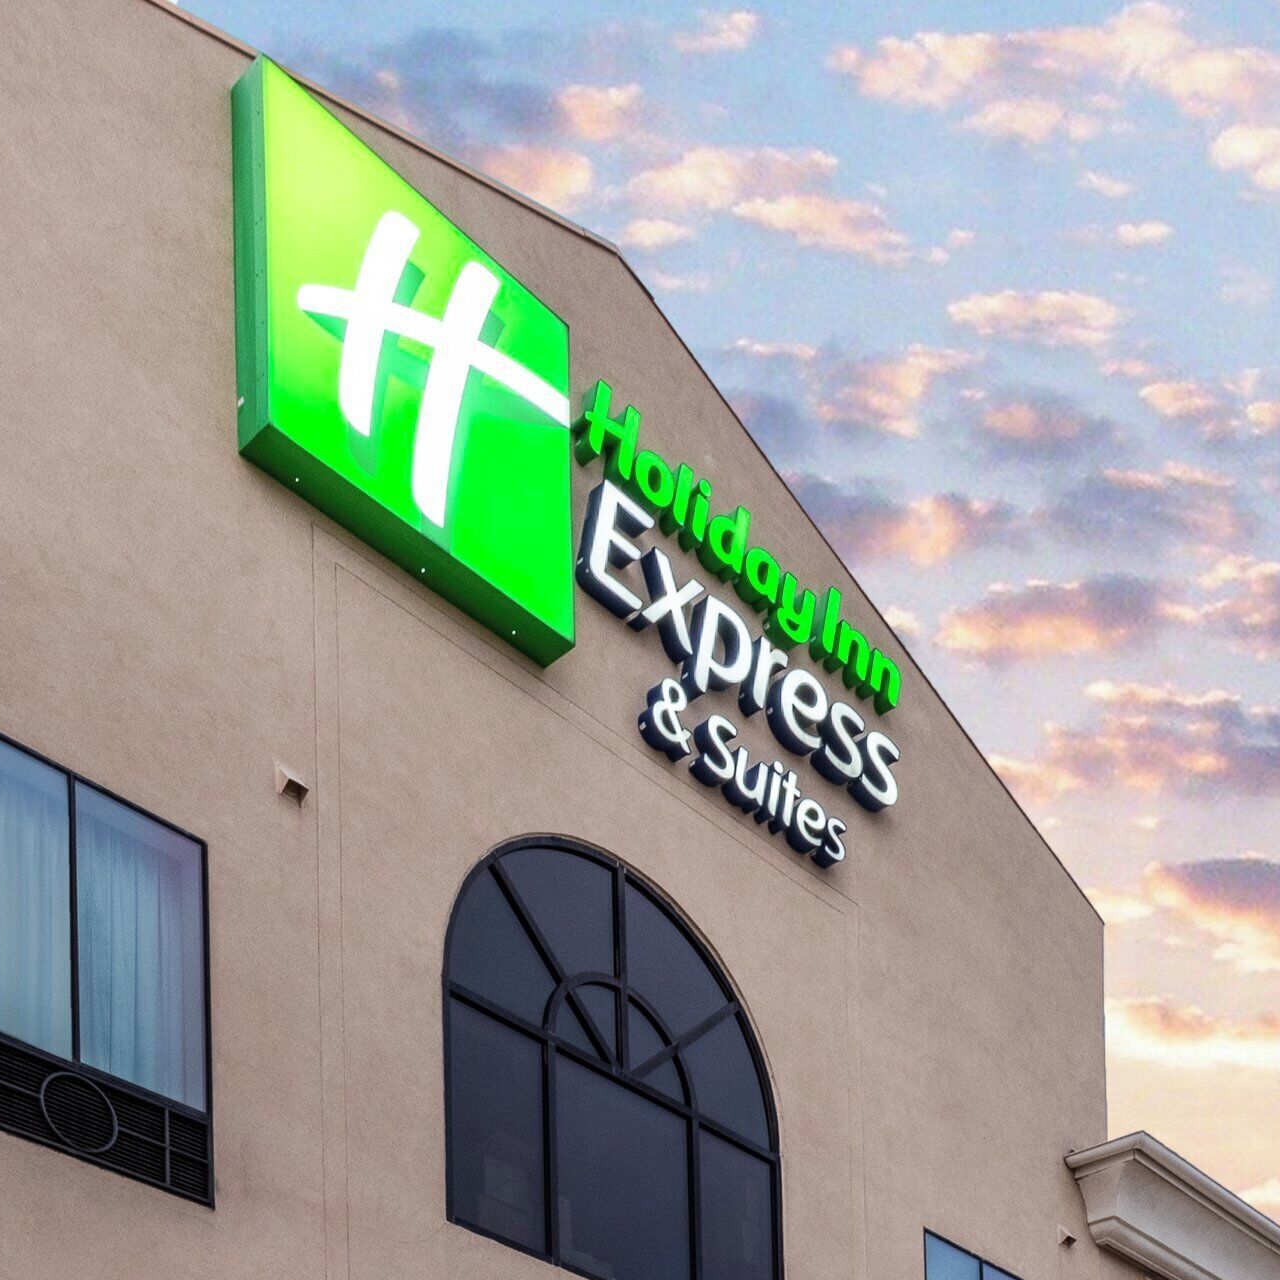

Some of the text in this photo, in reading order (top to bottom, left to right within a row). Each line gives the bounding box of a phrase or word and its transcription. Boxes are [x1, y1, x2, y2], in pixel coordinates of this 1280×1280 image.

[582, 378, 903, 710] Holiday Inn
[586, 478, 901, 808] Express
[649, 676, 849, 864] & Suites
